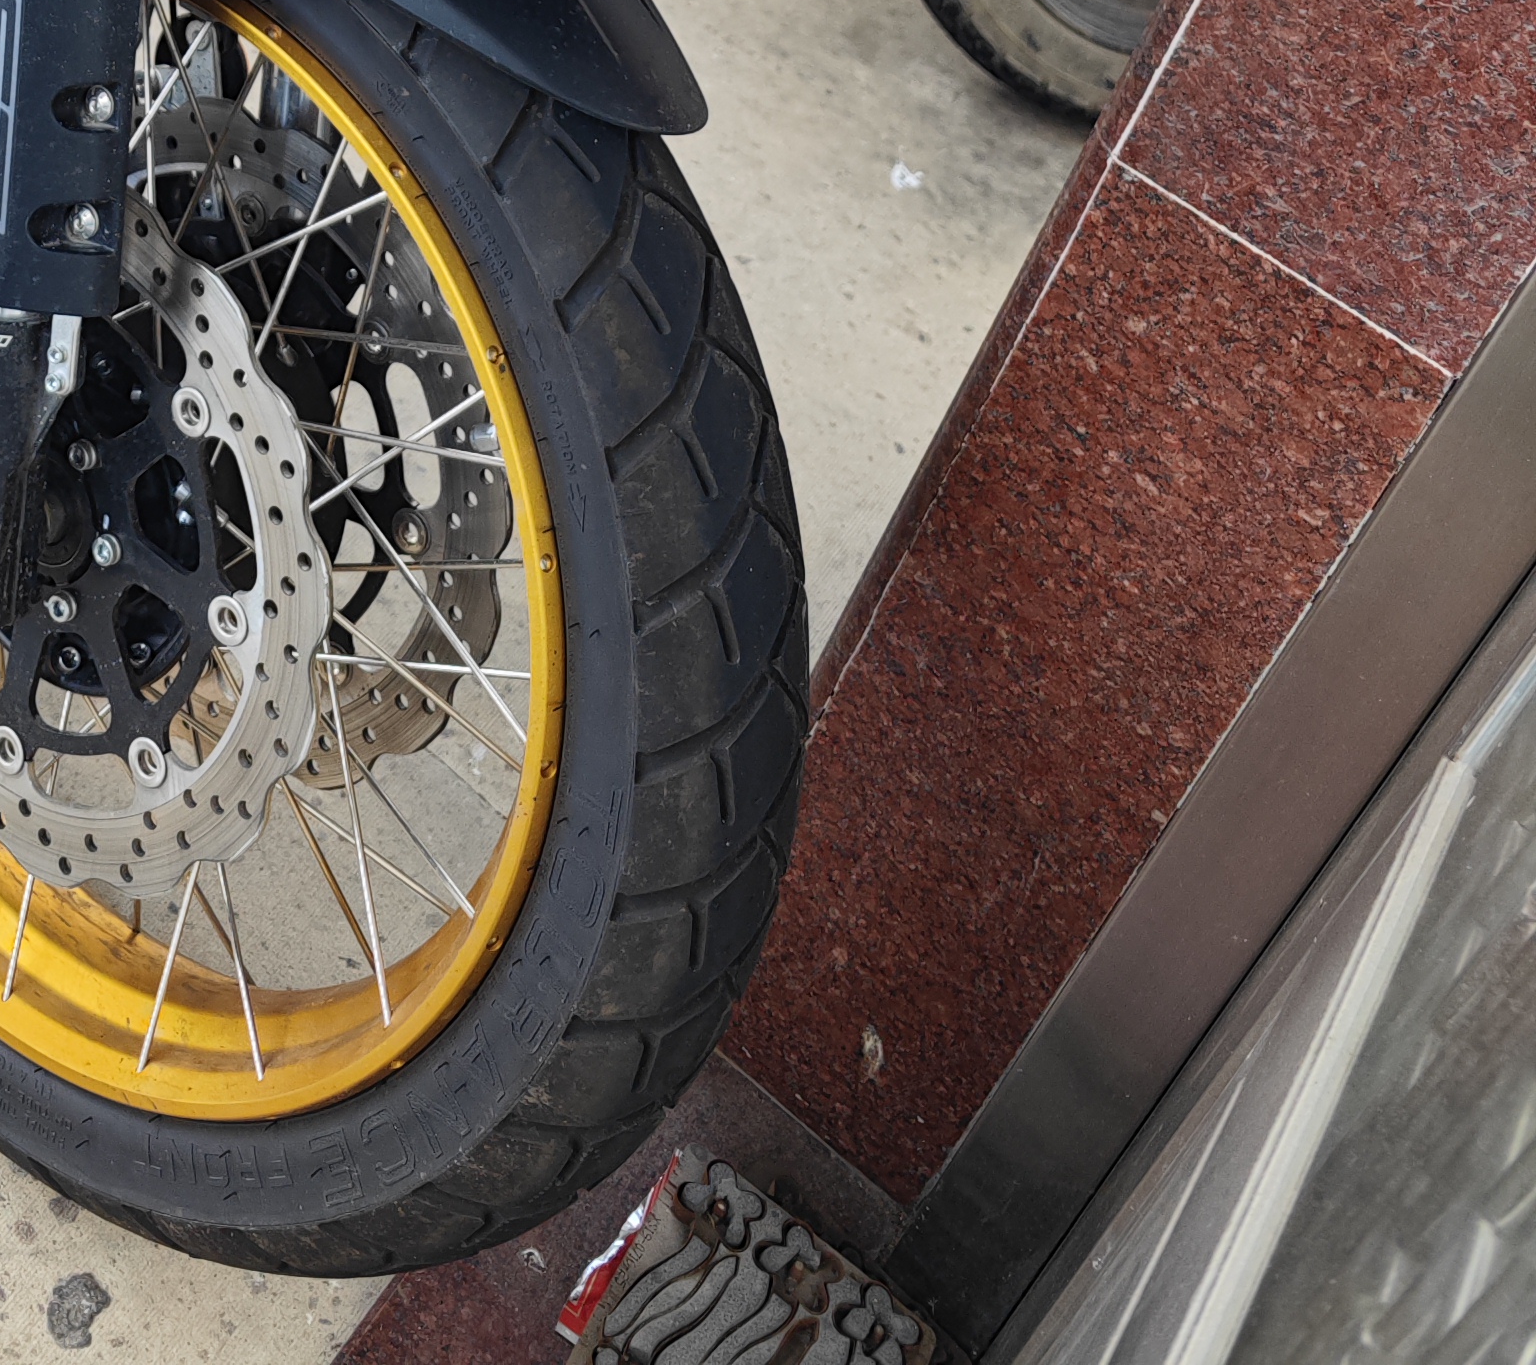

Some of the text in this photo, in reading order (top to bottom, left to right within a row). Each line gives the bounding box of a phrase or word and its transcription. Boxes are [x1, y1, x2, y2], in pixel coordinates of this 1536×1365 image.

[480, 245, 513, 311] WHEEL
[541, 379, 579, 476] ROTATION
[308, 785, 624, 1209] TOURANCE
